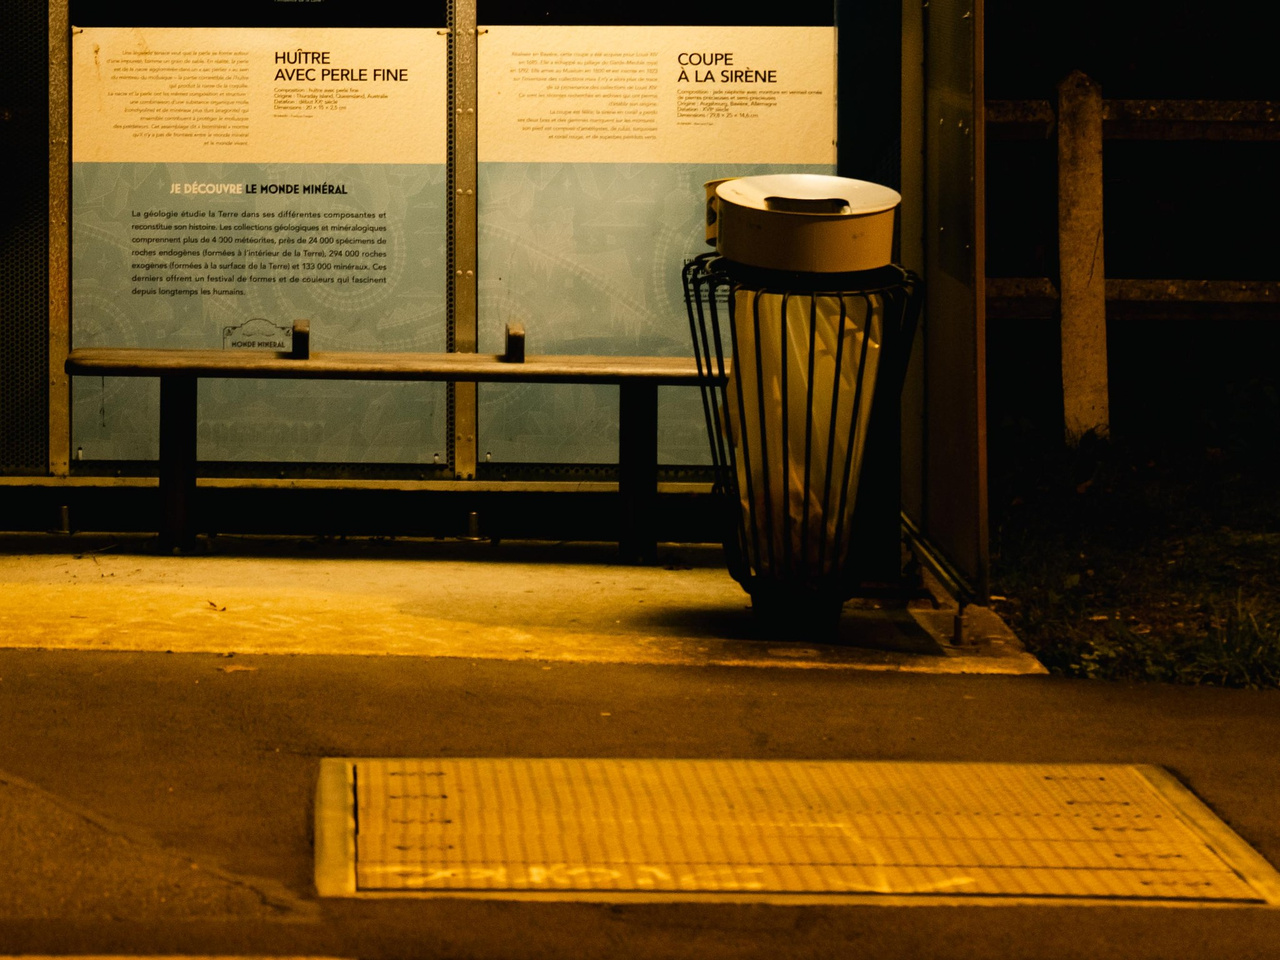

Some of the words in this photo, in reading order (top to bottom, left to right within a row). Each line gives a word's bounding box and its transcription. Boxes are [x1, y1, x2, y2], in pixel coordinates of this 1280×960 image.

[274, 48, 331, 65] HUÎTRE
[677, 52, 734, 66] COUPE
[273, 68, 317, 82] AVEC
[320, 68, 369, 82] PERLE
[372, 68, 409, 82] FINE
[677, 66, 689, 83] À
[694, 69, 715, 83] LA
[720, 66, 778, 83] SIRÈNE
[169, 183, 181, 194] JE
[183, 180, 243, 194] DÉCOUVRE
[245, 183, 258, 194] LE
[259, 183, 300, 194] MONDE
[302, 181, 348, 195] MINÉRAL
[131, 210, 142, 218] La
[142, 210, 179, 220] géologie
[180, 210, 206, 218] étudie
[207, 210, 216, 218] la
[217, 210, 239, 218] Terre
[240, 210, 260, 218] dans
[277, 210, 321, 218] différentes
[323, 210, 376, 220] composantes
[378, 210, 387, 219] et
[130, 222, 173, 231] reconstitue
[218, 223, 232, 231] Les
[233, 223, 273, 231] collections
[273, 223, 320, 233] géologiques
[320, 223, 329, 231] et
[330, 223, 387, 233] minéralogiques
[130, 235, 181, 246] comprennent
[182, 235, 199, 246] plus
[199, 235, 211, 244] de
[211, 236, 217, 244] 4
[278, 236, 295, 246] près
[296, 236, 307, 244] de
[308, 236, 318, 244] 24
[319, 236, 335, 244] 000
[335, 236, 375, 246] spécimens
[376, 236, 387, 245] de
[130, 248, 157, 257] roches
[158, 248, 201, 259] endogènes
[201, 249, 236, 259] (formées
[236, 249, 243, 257] à
[243, 249, 280, 257] l'intérieur
[281, 249, 292, 257] de
[293, 249, 301, 257] la
[328, 249, 343, 257] 294
[344, 249, 360, 258] 000
[361, 249, 387, 258] roches
[130, 261, 168, 272] exogènes
[168, 261, 202, 272] (formées
[203, 261, 209, 270] à
[209, 261, 217, 270] la
[218, 262, 246, 270] surface
[247, 262, 258, 270] de
[259, 262, 267, 270] la
[268, 262, 291, 272] Terre)
[291, 262, 300, 270] et
[301, 262, 316, 270] 133
[316, 262, 332, 270] 000
[372, 262, 387, 271] Ces
[131, 274, 164, 282] derniers
[165, 274, 192, 283] offrent
[206, 274, 235, 283] festival
[236, 274, 247, 283] de
[249, 275, 277, 283] formes
[278, 275, 287, 283] et
[288, 275, 300, 283] de
[301, 275, 335, 283] couleurs
[336, 275, 350, 285] qui
[351, 275, 387, 283] fascinent
[131, 287, 157, 297] depuis
[157, 287, 199, 297] longtemps
[200, 287, 211, 296] les
